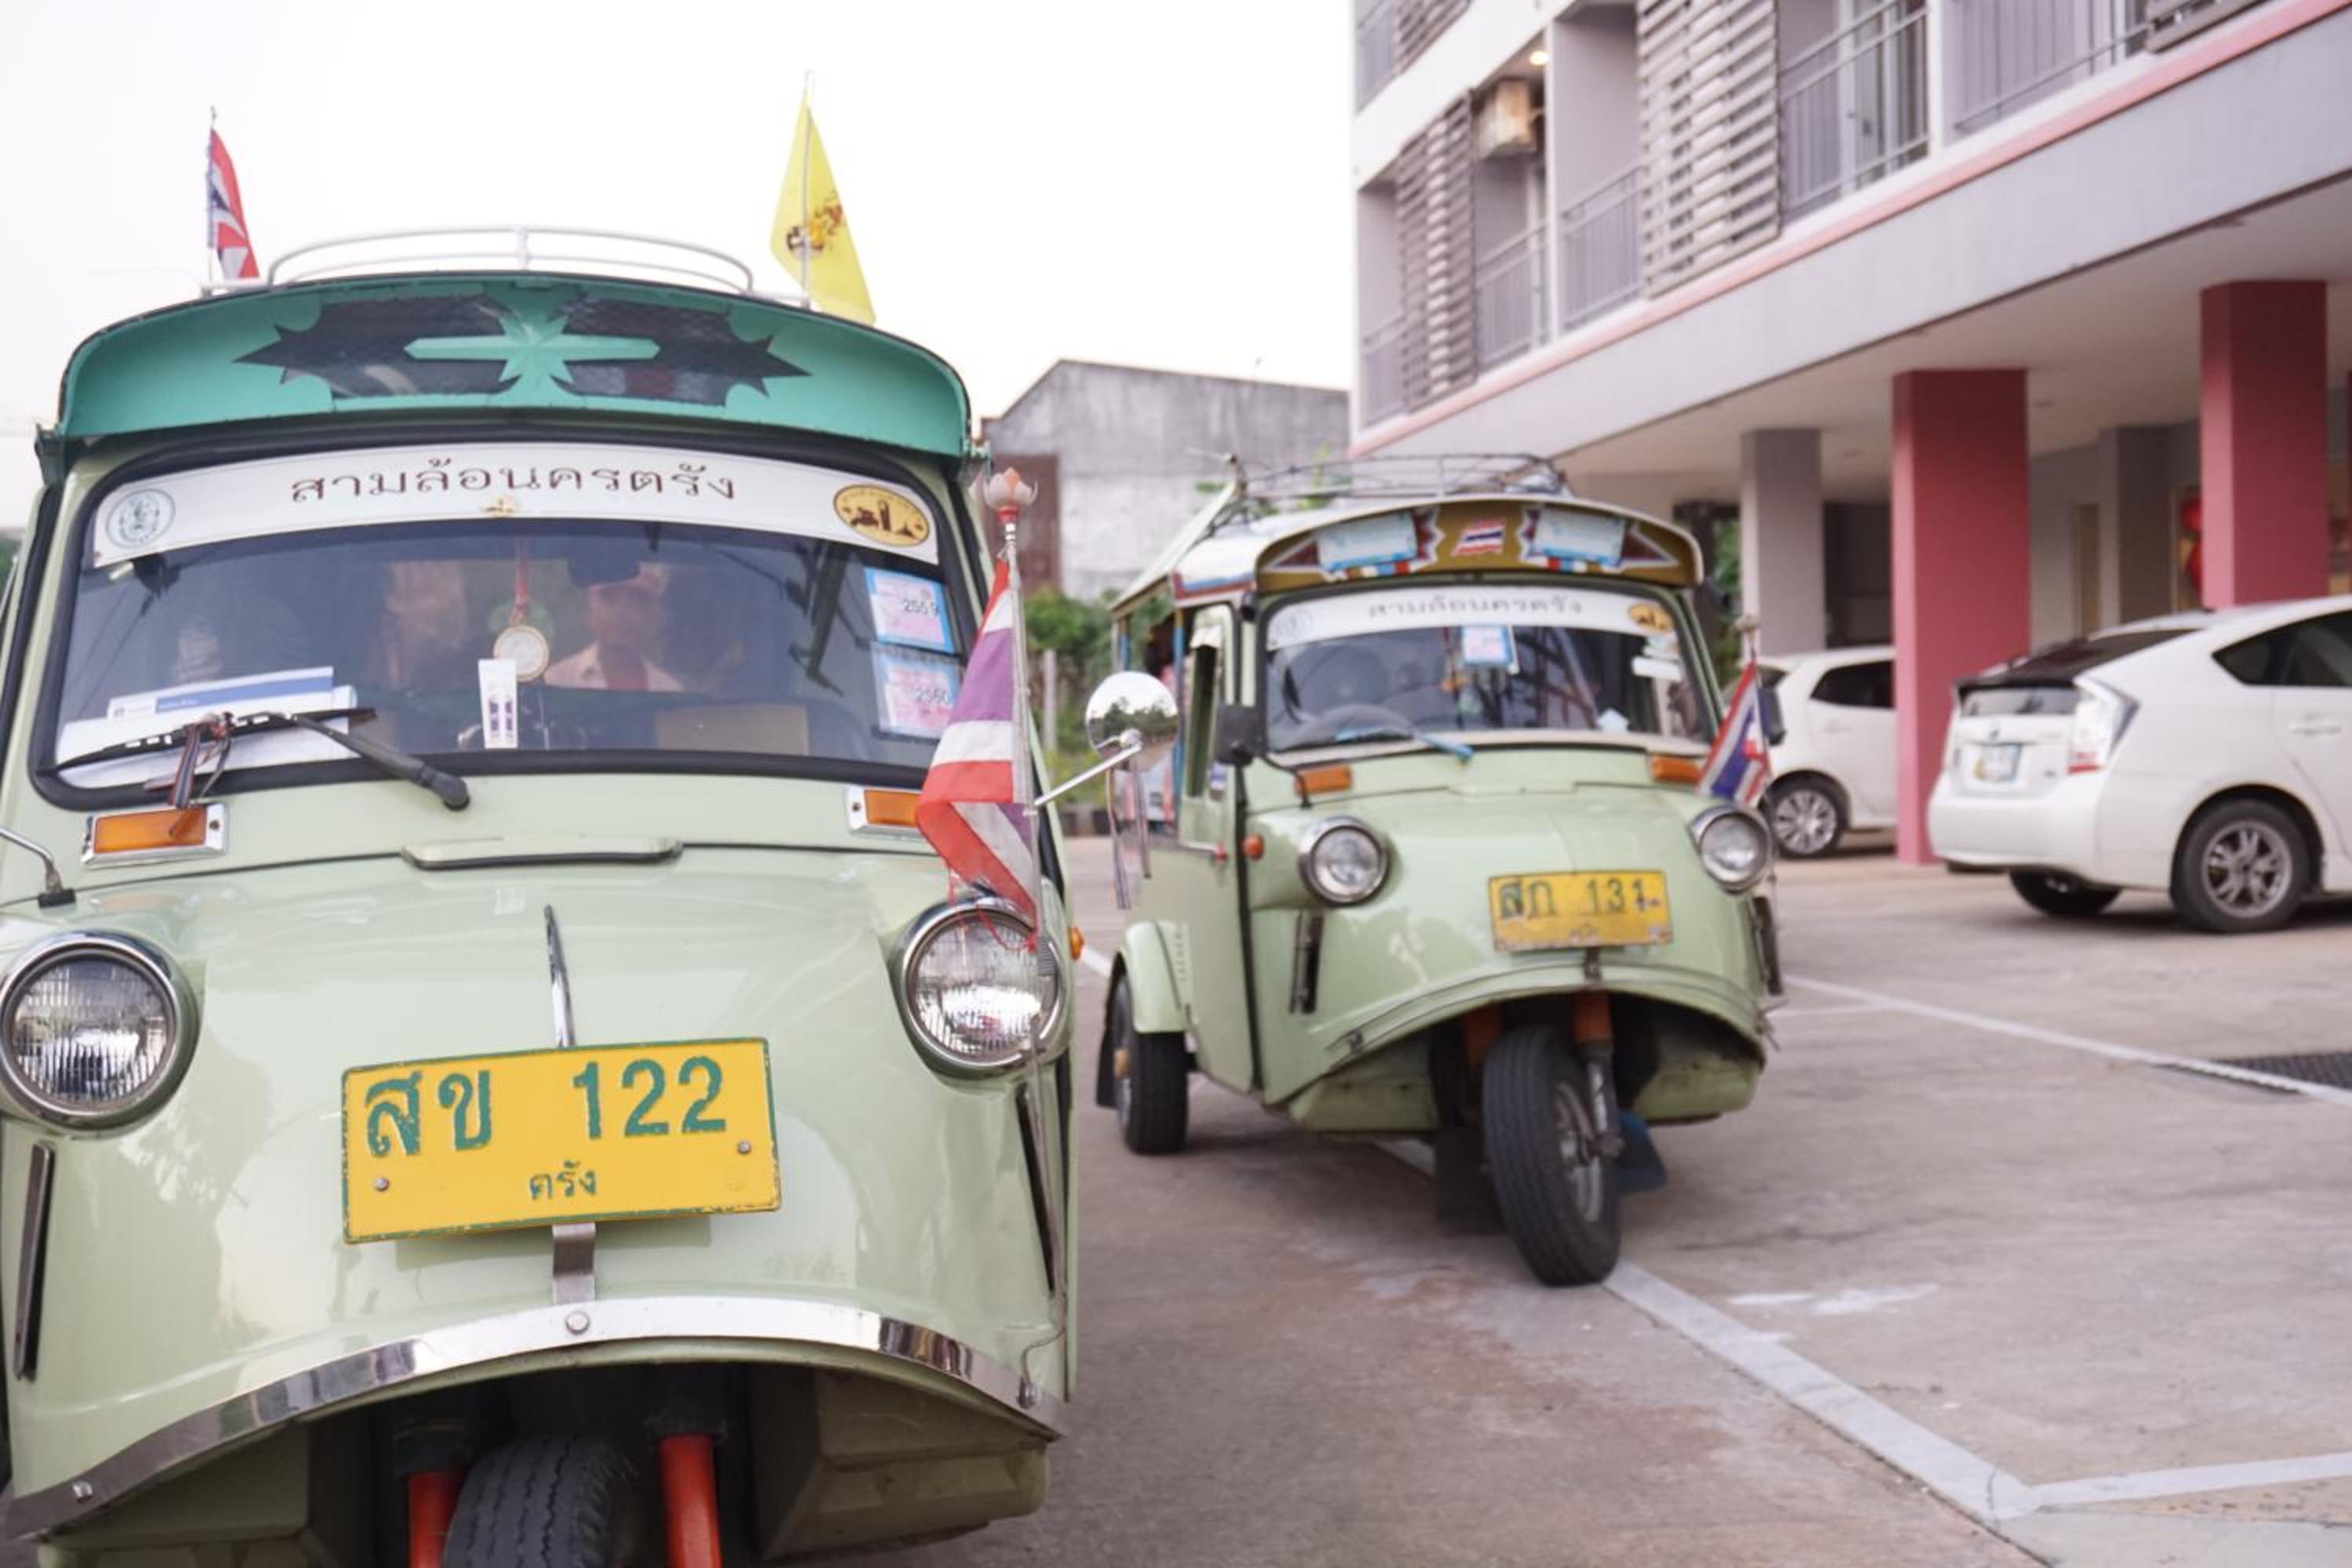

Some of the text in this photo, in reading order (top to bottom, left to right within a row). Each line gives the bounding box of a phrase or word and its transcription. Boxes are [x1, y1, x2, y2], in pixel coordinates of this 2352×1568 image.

[292, 457, 735, 503] สามล้อนครตรัง
[1587, 877, 1646, 916] 131
[365, 1055, 727, 1157] สข 122
